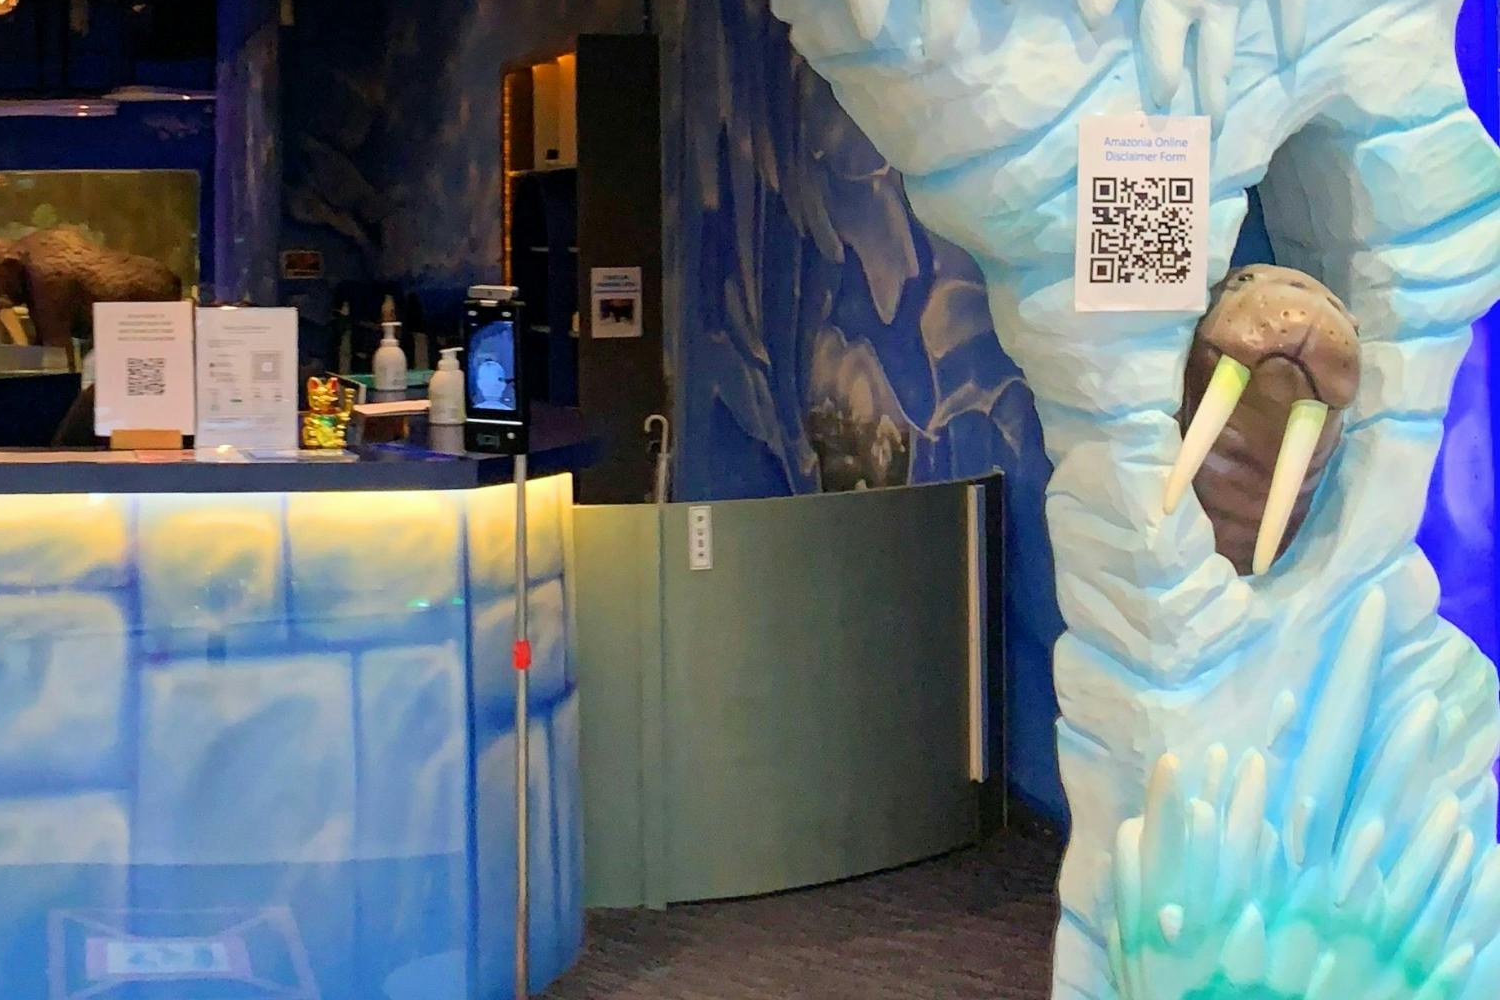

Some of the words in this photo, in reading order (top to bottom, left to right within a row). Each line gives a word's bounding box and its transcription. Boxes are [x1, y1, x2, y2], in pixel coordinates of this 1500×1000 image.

[1103, 136, 1153, 148] Amazonia
[1154, 136, 1189, 148] Online
[1105, 150, 1158, 162] Disclaimer
[1159, 151, 1187, 162] Form
